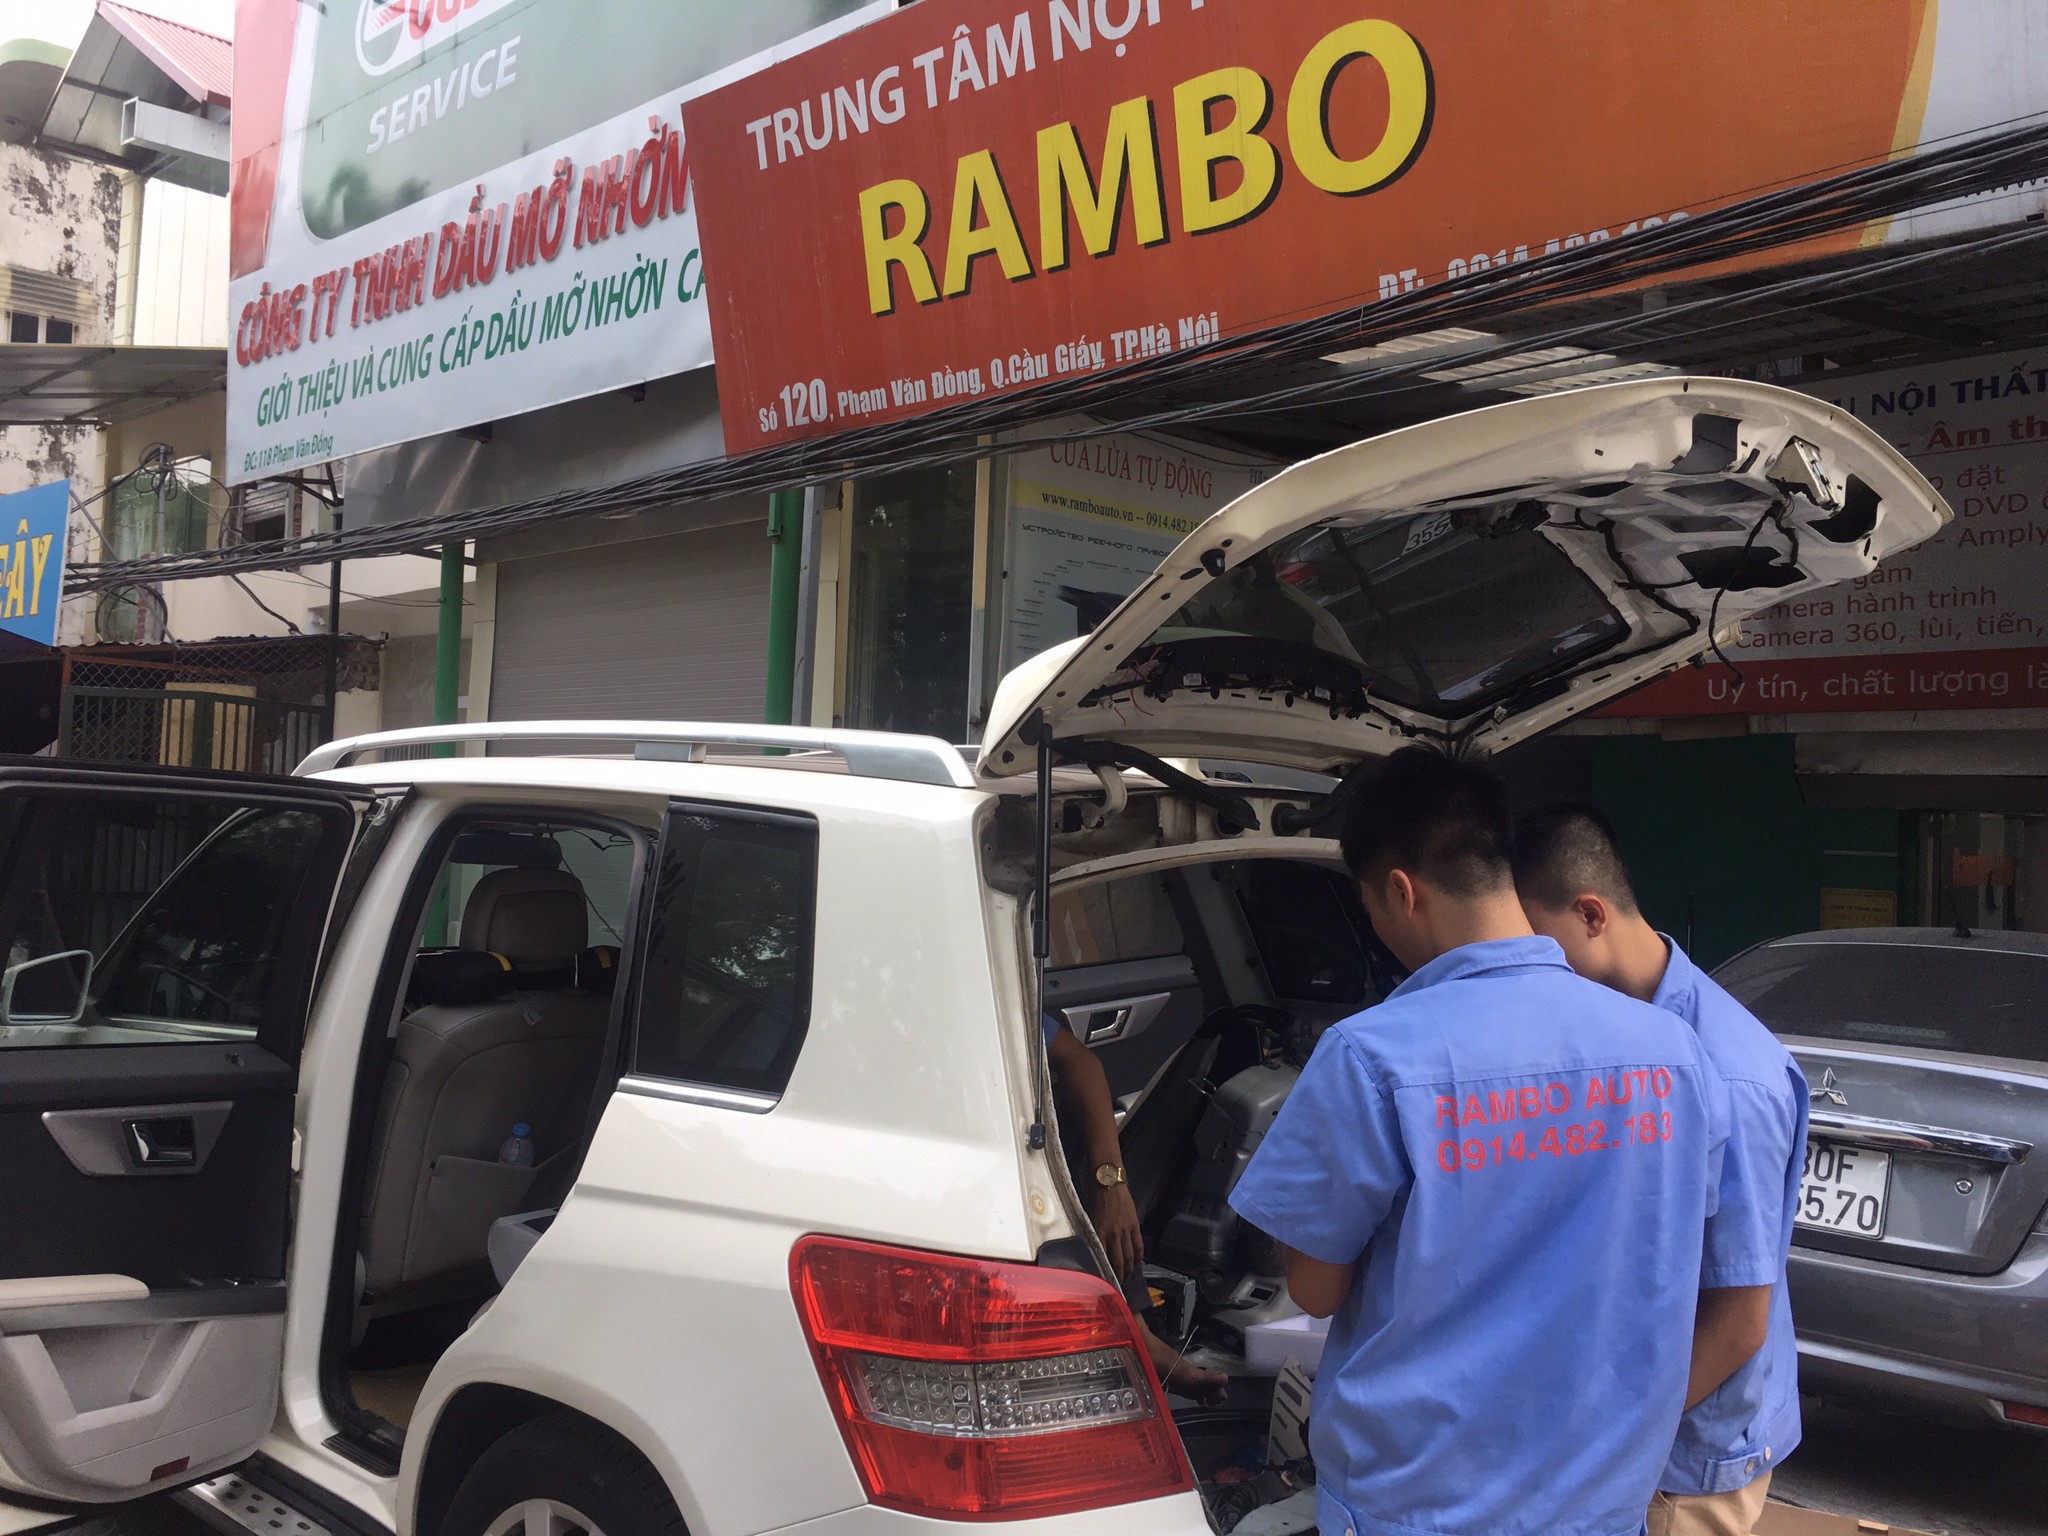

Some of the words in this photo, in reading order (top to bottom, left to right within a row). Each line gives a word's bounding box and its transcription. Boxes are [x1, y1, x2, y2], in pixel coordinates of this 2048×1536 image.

[366, 35, 522, 154] SERVICE
[746, 66, 906, 170] TRUNG
[911, 10, 1036, 109] TÂM
[858, 18, 1436, 318] RAMBO
[236, 281, 307, 368] CÔNG
[309, 266, 350, 343] TY
[350, 229, 433, 329] TNHH
[432, 183, 507, 299] DẦU
[505, 156, 574, 274] MỠ
[256, 372, 293, 427] GIỚI
[297, 358, 349, 419] THIỆU
[352, 345, 374, 400] VÀ
[377, 333, 434, 393] CUNG
[439, 304, 485, 373] CẤP
[484, 289, 537, 360] DẦU
[538, 270, 587, 344] MỠ
[585, 252, 668, 331] NHỜN
[779, 378, 834, 428] 120,
[837, 386, 888, 418] Phạm
[890, 377, 927, 407] Văn
[931, 364, 986, 400] Đồng,
[990, 348, 1049, 389] Q.Cầu
[1054, 334, 1106, 375] Giấy,
[1871, 381, 1936, 416] NỘI
[1951, 361, 2048, 403] THẤT
[258, 447, 272, 468] 118
[272, 444, 295, 467] Phạm
[1926, 420, 1991, 450] Âm
[1164, 457, 1213, 499] ĐỘNG
[1957, 464, 2006, 490] đặt
[1042, 492, 1134, 522] www.ramboauto.vn
[1963, 493, 2029, 517] DVD
[1847, 591, 1915, 614] hành
[1928, 585, 1996, 607] trình
[1736, 628, 1834, 649] Camera
[1846, 620, 1907, 645] 360,
[1919, 616, 1962, 641] lùi,
[1757, 673, 1808, 701] tín,
[1823, 668, 1895, 696] chất
[1910, 668, 2009, 697] lượng
[1435, 1082, 1571, 1129] RAMBO
[1585, 1067, 1672, 1111] AUTO
